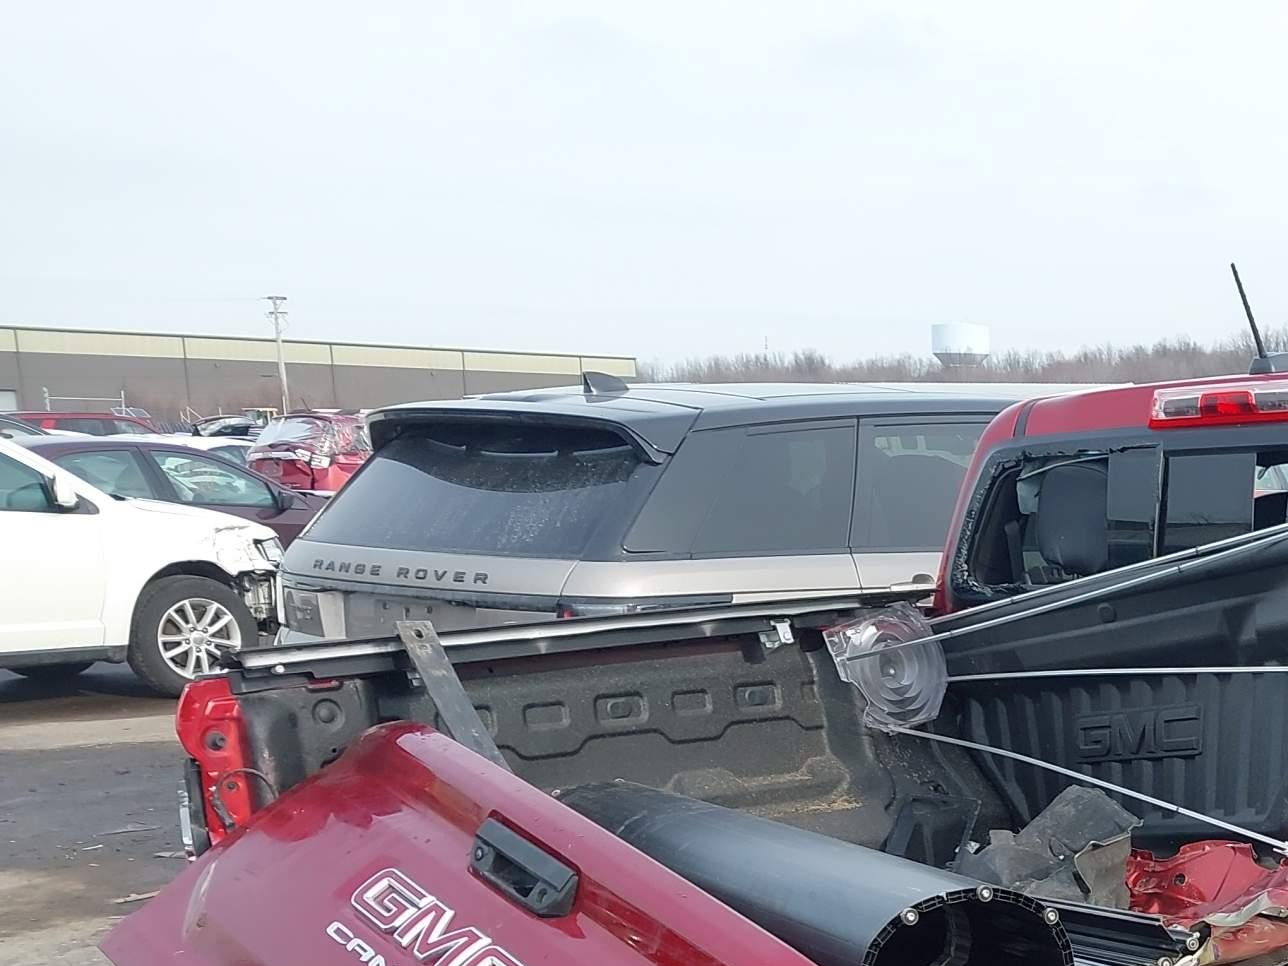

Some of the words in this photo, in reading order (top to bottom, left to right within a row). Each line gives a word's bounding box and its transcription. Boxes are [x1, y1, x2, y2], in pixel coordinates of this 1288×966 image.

[312, 559, 383, 577] RANGE
[396, 566, 489, 585] ROVER
[1076, 704, 1203, 760] GMC
